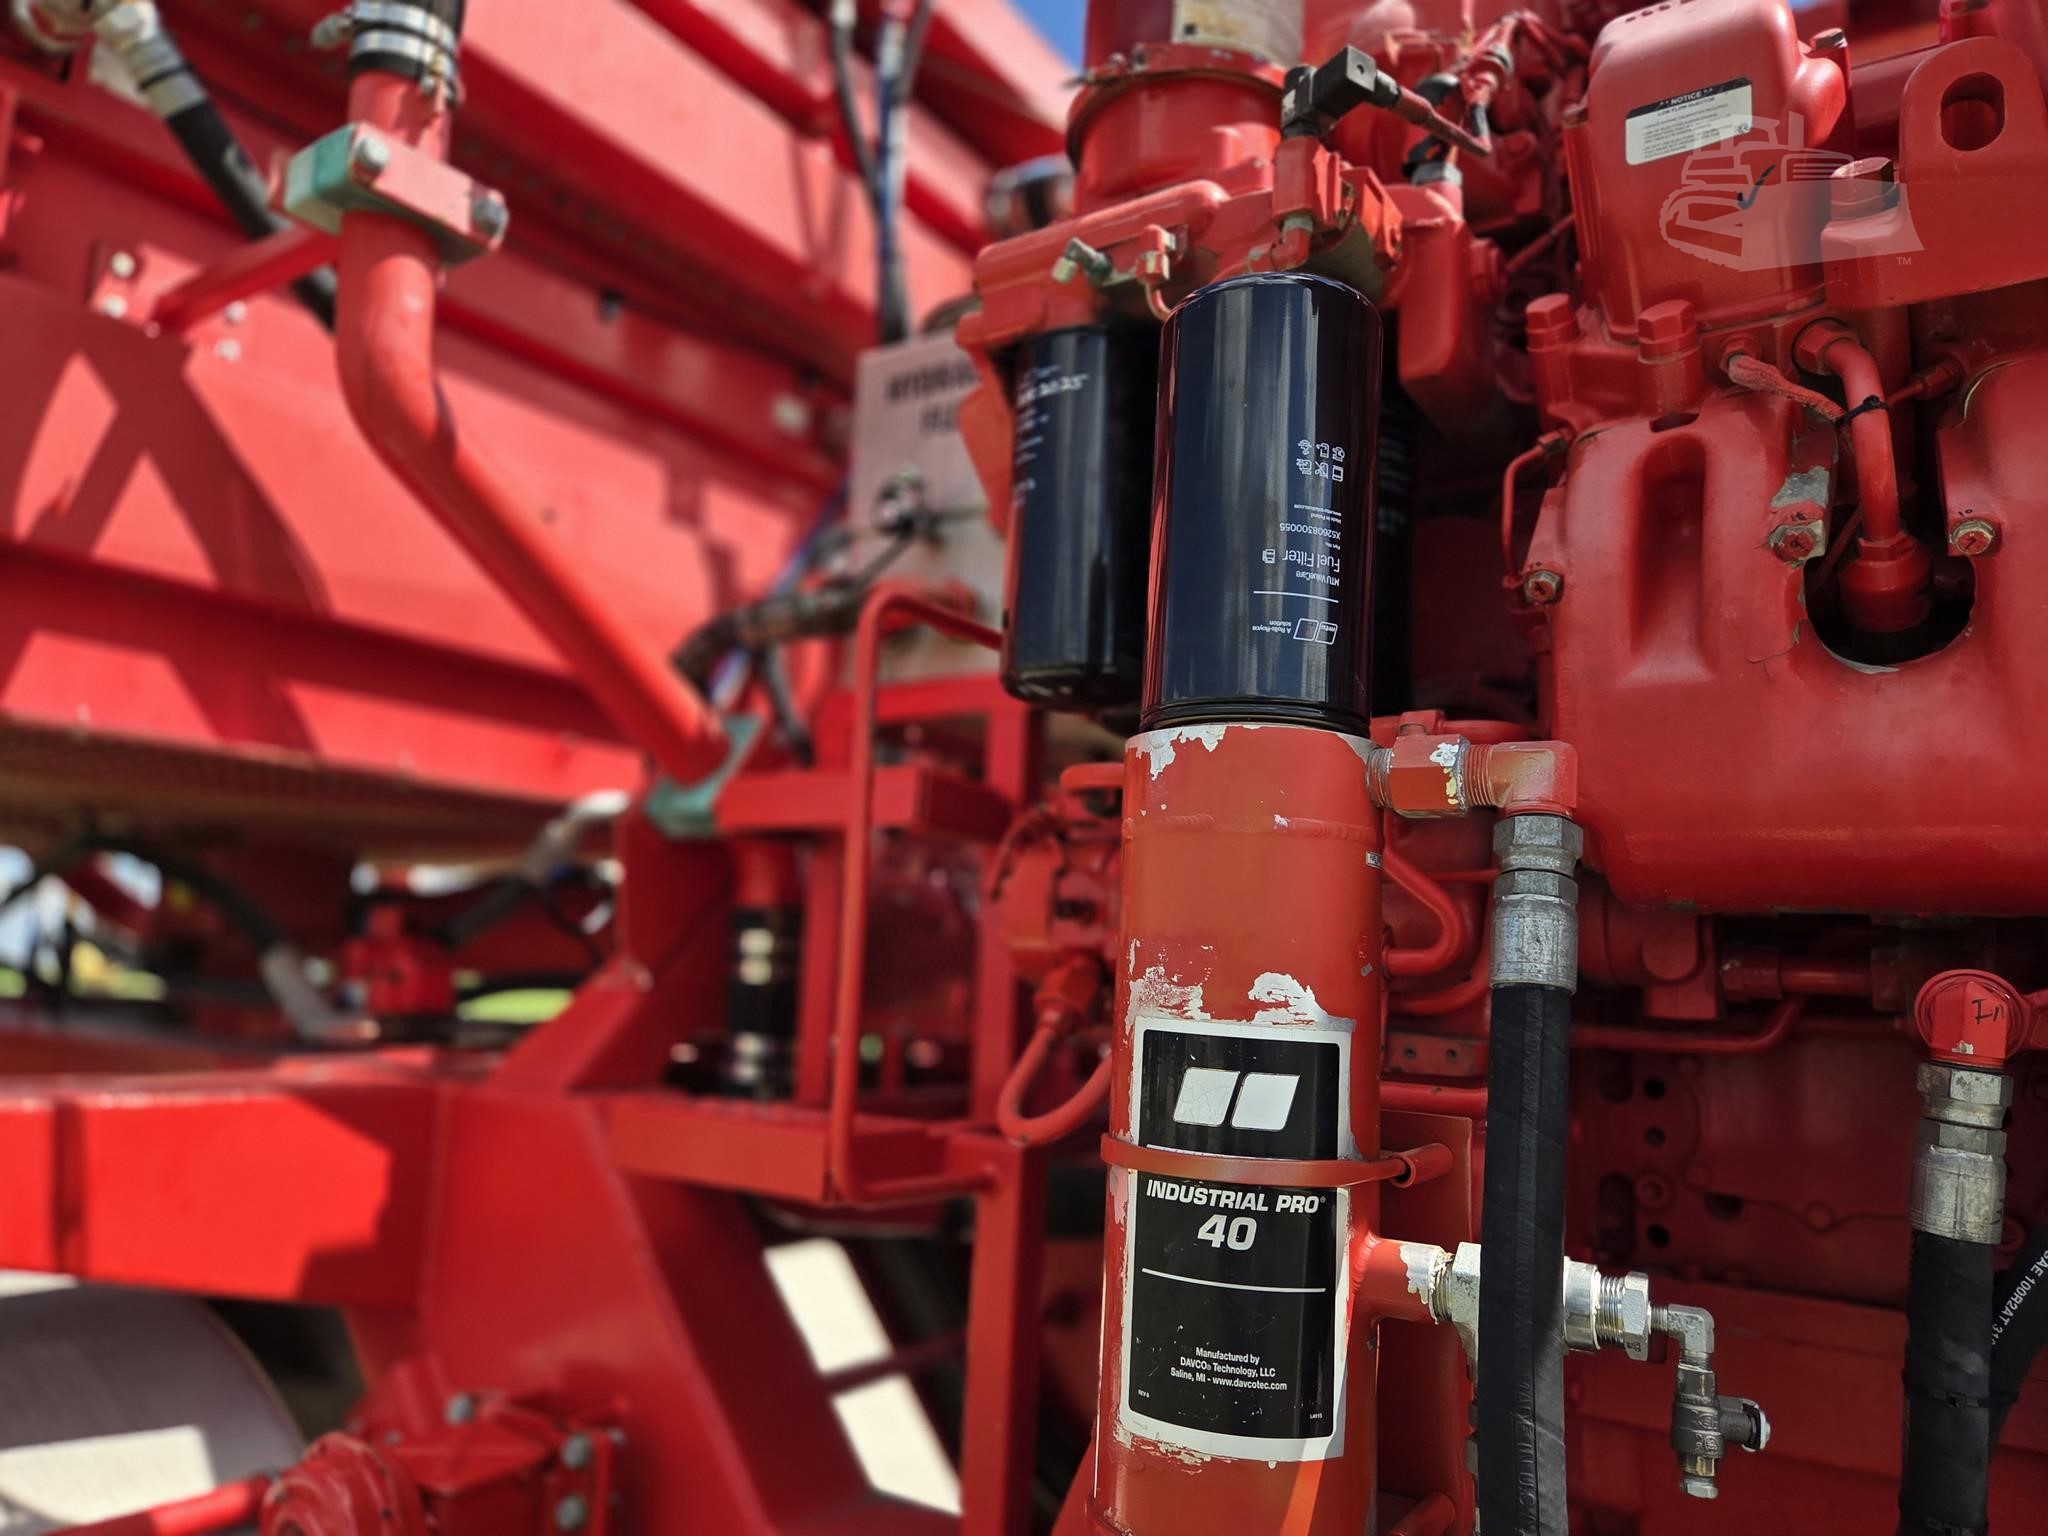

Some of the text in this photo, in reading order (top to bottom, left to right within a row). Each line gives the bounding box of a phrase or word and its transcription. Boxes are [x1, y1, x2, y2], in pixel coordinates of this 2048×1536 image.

[1670, 91, 1702, 105] NOTICE
[1282, 549, 1340, 573] Fuel Filter
[1296, 570, 1340, 587] MTU ValueCare
[1252, 624, 1286, 634] Rolls-Royce
[1146, 1179, 1269, 1212] INDUSTRIAL
[1197, 1214, 1258, 1250] 40
[1999, 1275, 2036, 1326] 100R2AT
[1195, 1347, 1260, 1365] Manufactured by
[1170, 1367, 1194, 1382] Saline,
[1195, 1372, 1206, 1383] MI
[1212, 1376, 1288, 1391] www.davcotec.com
[1213, 1362, 1258, 1378] Technology,
[1259, 1367, 1276, 1378] LLC
